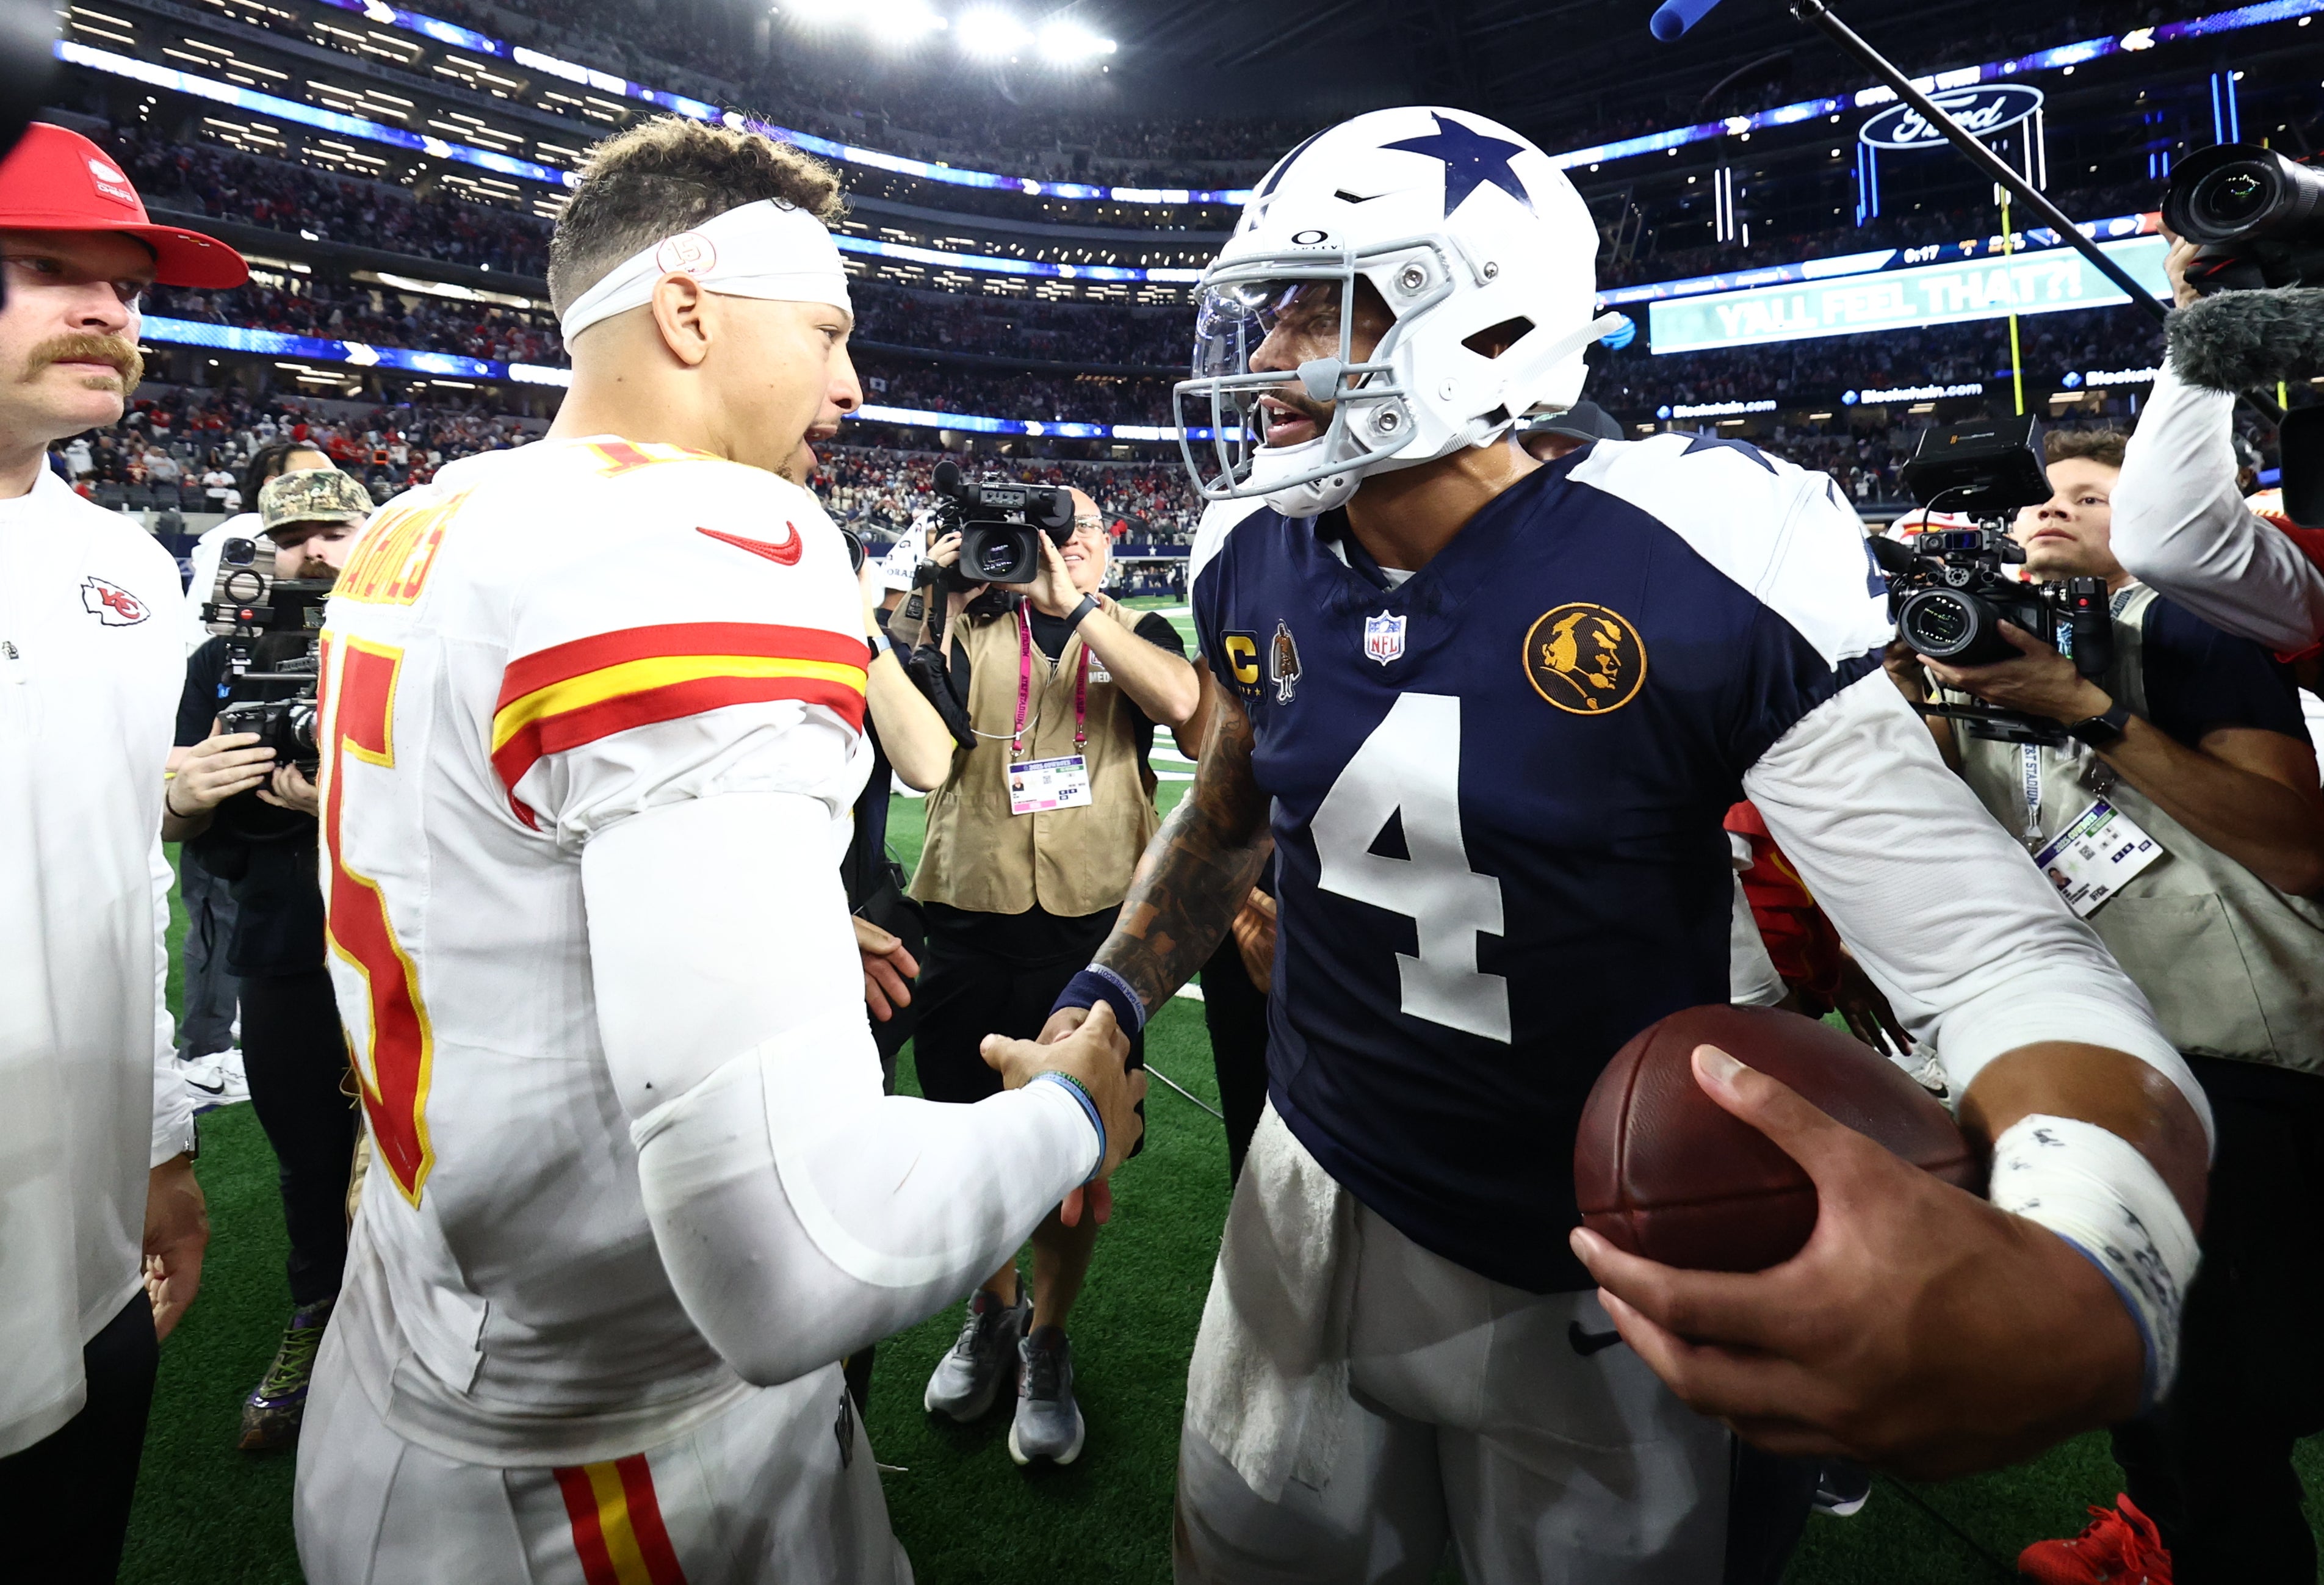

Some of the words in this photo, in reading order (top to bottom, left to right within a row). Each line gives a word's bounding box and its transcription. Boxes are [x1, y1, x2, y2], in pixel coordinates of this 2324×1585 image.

[1893, 93, 2006, 143] Frd
[1822, 281, 1917, 325] FEEL
[1673, 400, 1776, 418] Blockchain.com
[1861, 383, 1982, 404] Blockchain.com
[1225, 636, 1258, 684] C
[1371, 635, 1397, 655] NFL
[2026, 763, 2038, 805] STADIUM
[1310, 692, 1511, 1044] 4
